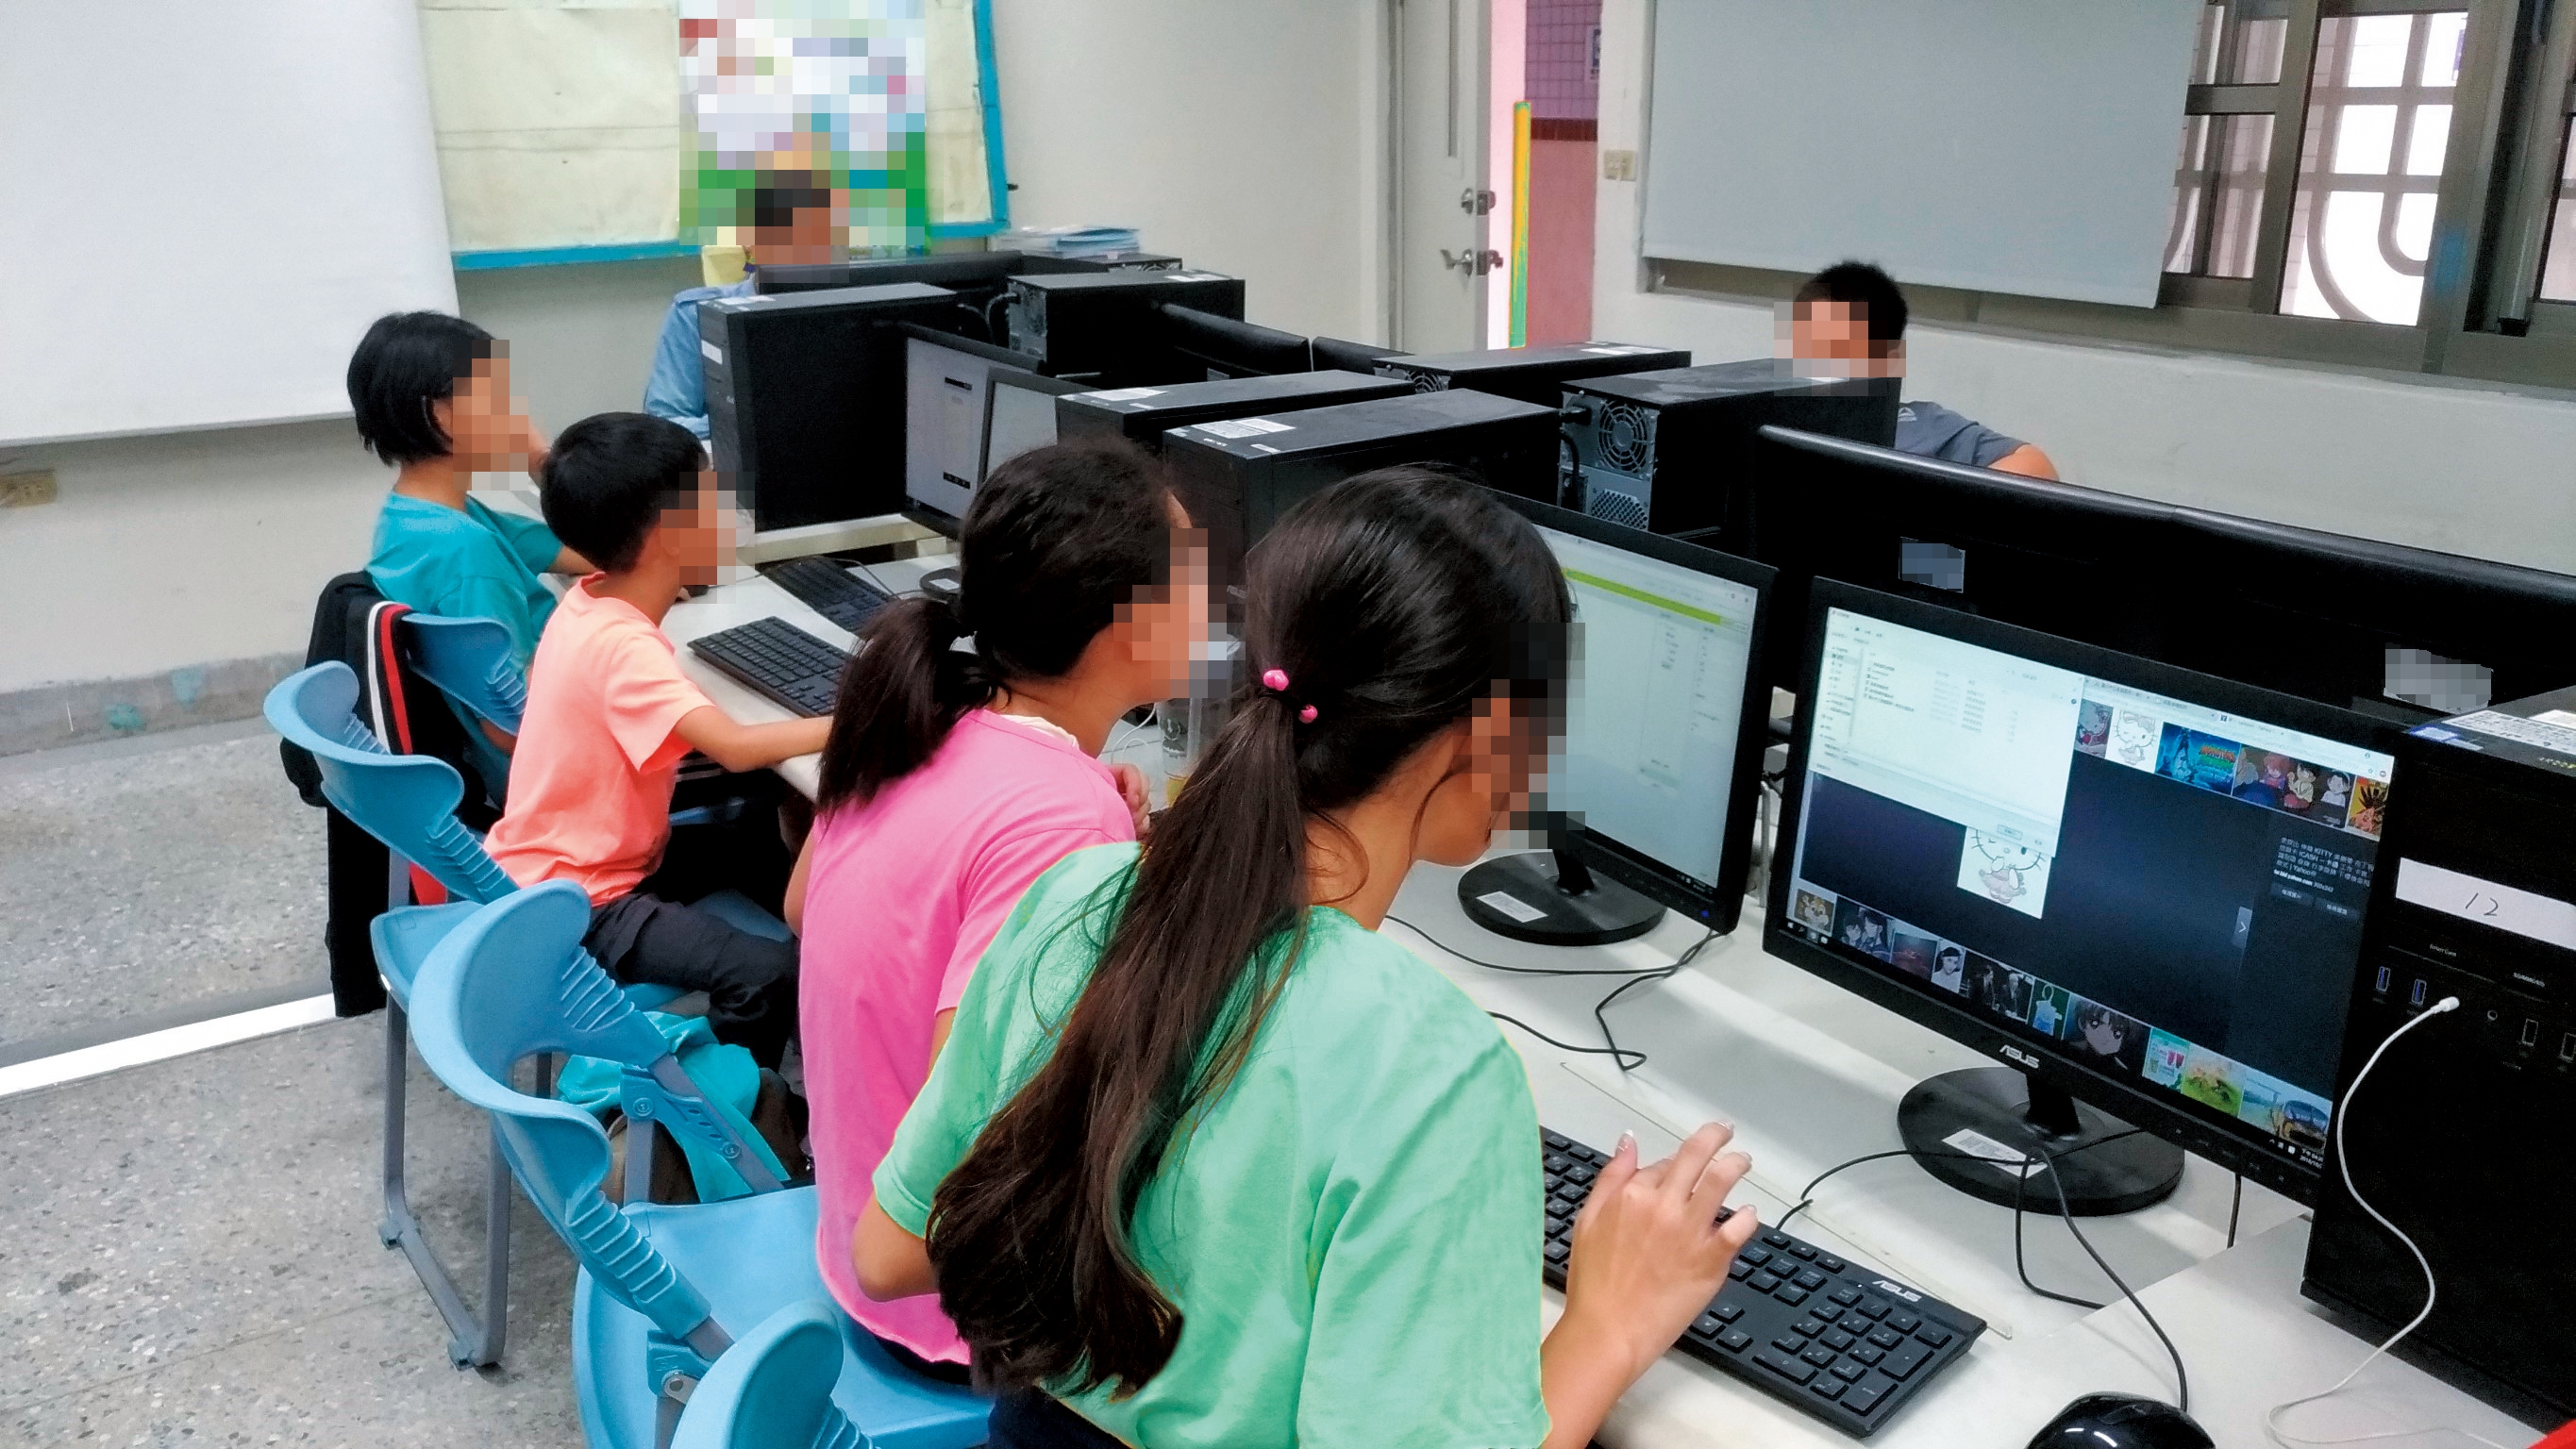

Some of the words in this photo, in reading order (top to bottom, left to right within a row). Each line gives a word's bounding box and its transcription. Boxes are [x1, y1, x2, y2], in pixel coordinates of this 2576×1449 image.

[2466, 892, 2499, 916] 12
[1999, 1044, 2040, 1069] ASUS
[1872, 1279, 1922, 1302] ASUS
